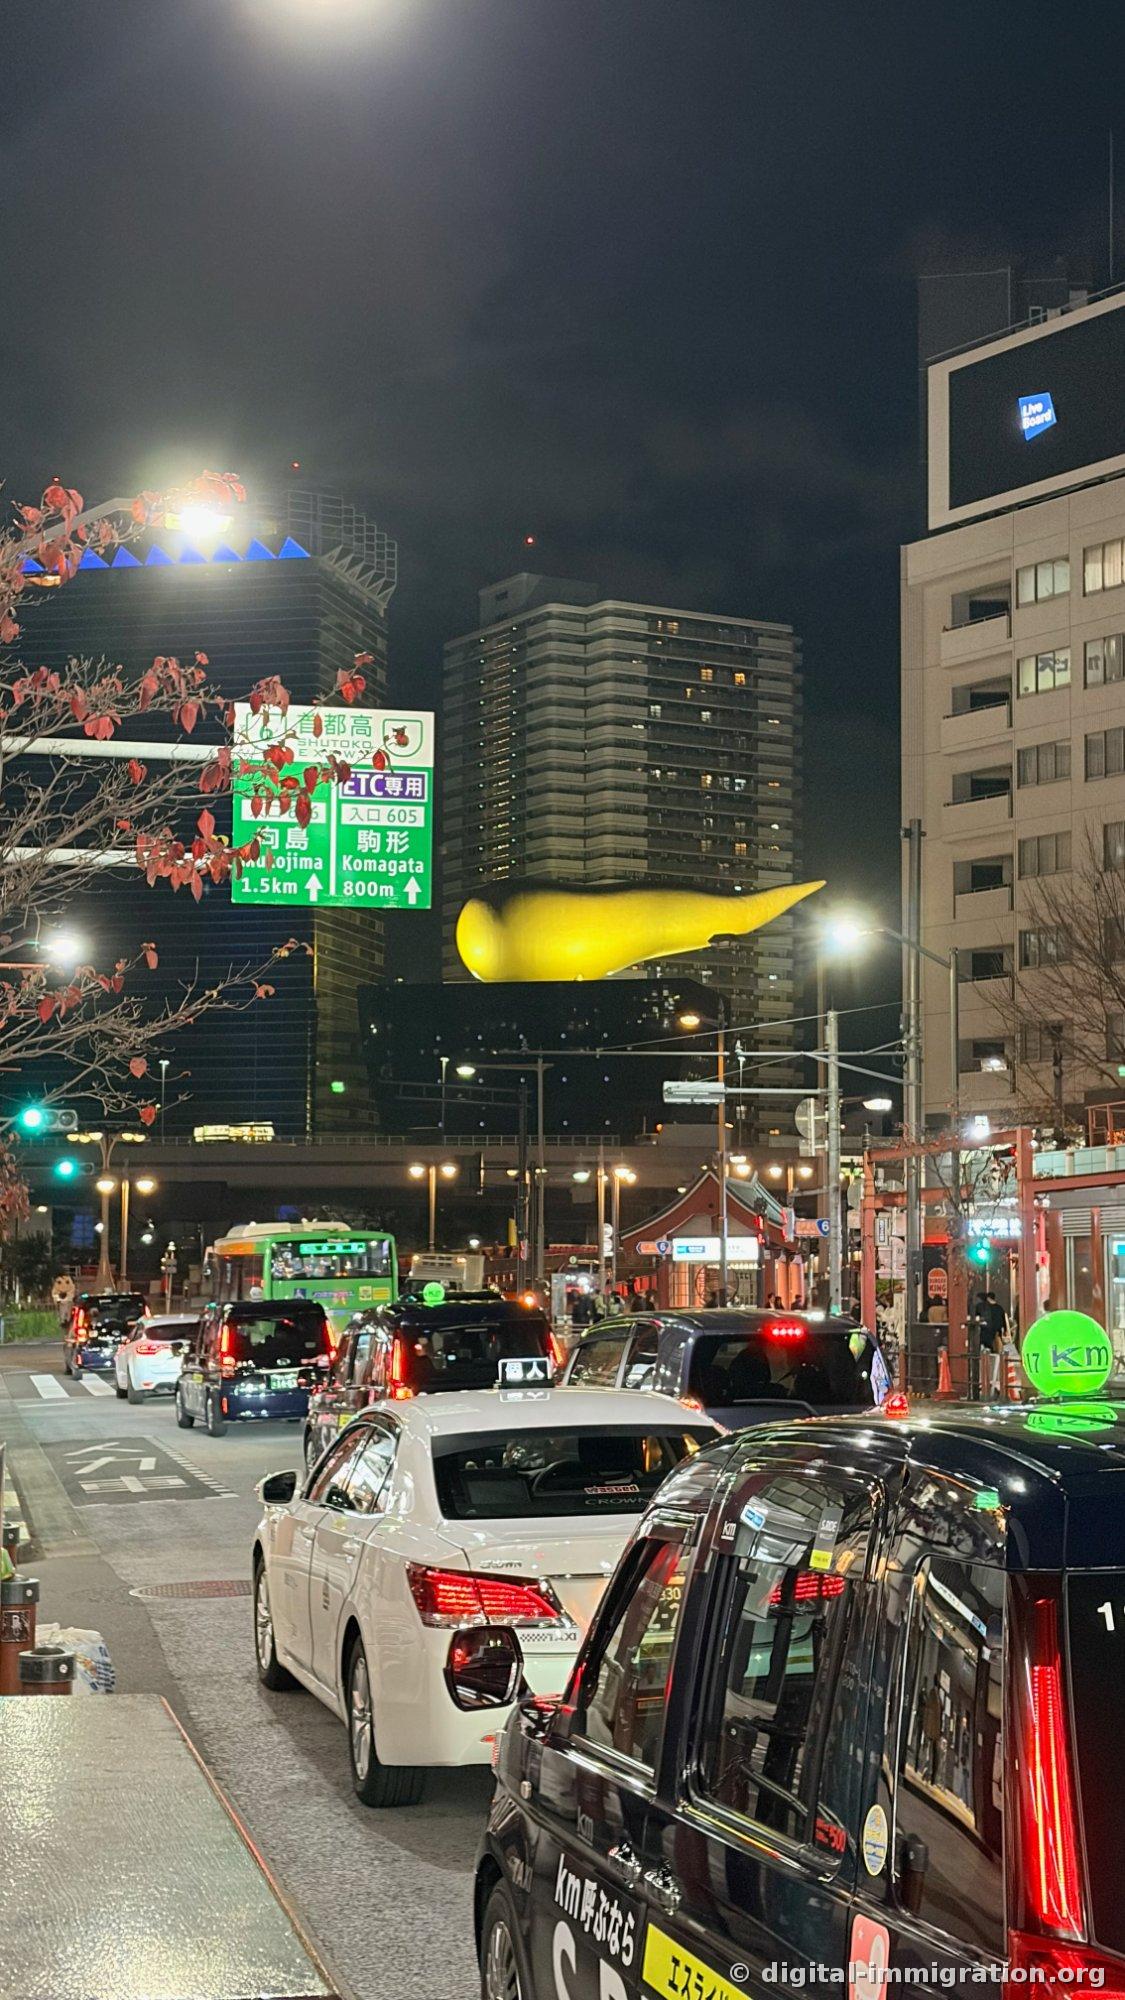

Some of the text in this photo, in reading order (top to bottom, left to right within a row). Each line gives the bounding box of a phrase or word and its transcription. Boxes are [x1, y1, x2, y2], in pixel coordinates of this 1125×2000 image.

[1022, 402, 1043, 416] Live
[1022, 408, 1052, 430] Board
[297, 712, 373, 738] 首都高
[297, 739, 372, 751] SHUTOKO
[343, 773, 423, 797] ETC専用
[350, 807, 417, 824] 入口 605
[357, 829, 410, 854] 駒形
[342, 854, 425, 877] Komagata
[241, 876, 299, 895] 1.5km
[342, 880, 395, 897] 800m
[821, 1221, 830, 1232] 6
[659, 1241, 667, 1251] 6
[929, 1284, 947, 1292] KING
[722, 1520, 737, 1538] km
[577, 1805, 594, 1842] km
